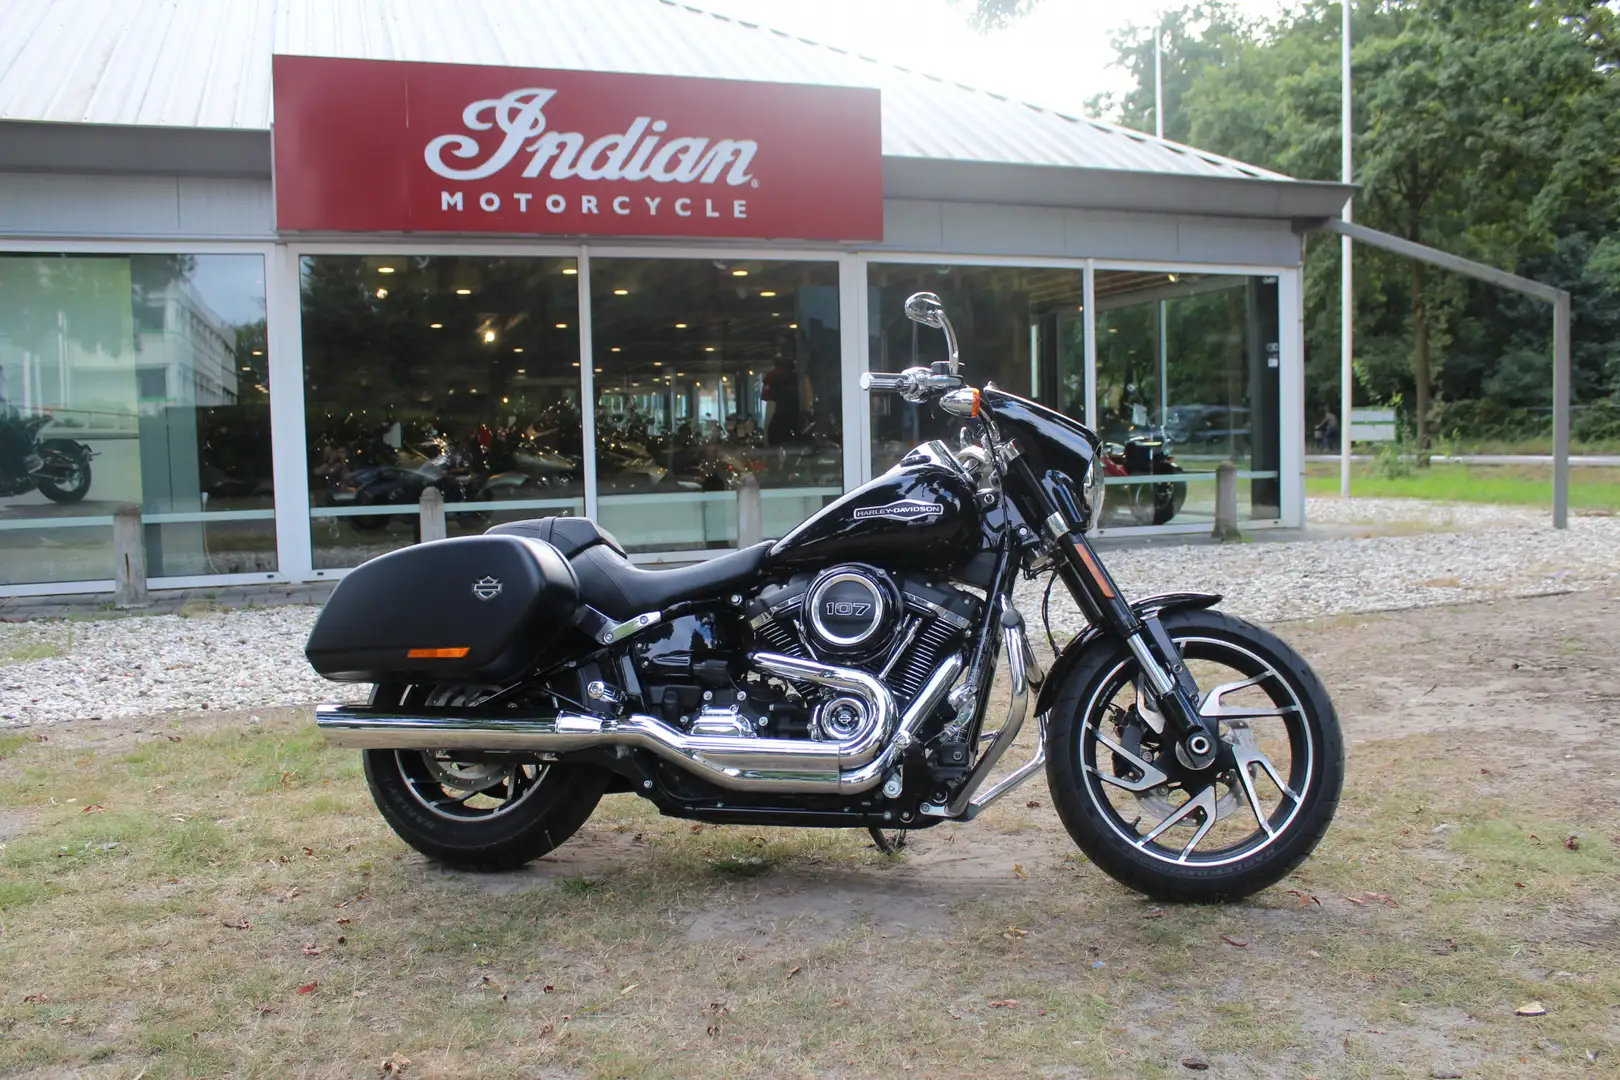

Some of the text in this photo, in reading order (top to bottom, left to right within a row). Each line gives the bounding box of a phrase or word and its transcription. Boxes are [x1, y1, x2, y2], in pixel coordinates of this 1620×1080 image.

[424, 87, 758, 186] Indian
[441, 191, 747, 218] MOTORCYCLE
[856, 505, 940, 518] HARLEY-DAVIDSON
[826, 601, 871, 616] 107
